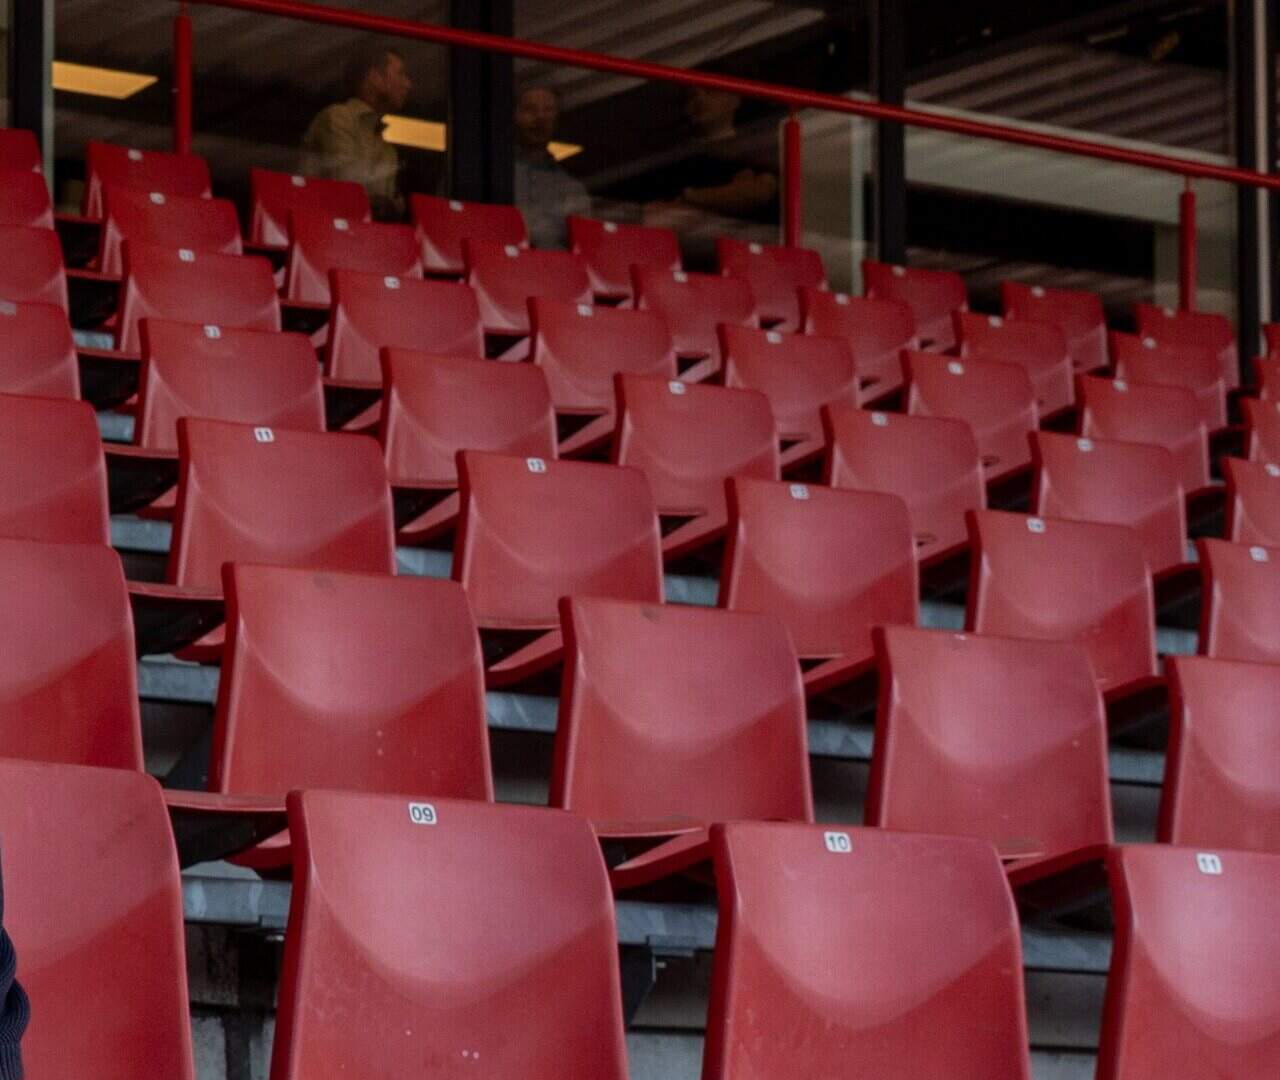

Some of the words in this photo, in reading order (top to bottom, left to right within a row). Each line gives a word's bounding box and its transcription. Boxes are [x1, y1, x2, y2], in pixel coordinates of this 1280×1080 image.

[257, 430, 271, 440] 11
[412, 806, 434, 822] 09
[828, 835, 847, 850] 10
[1200, 857, 1218, 870] 11
